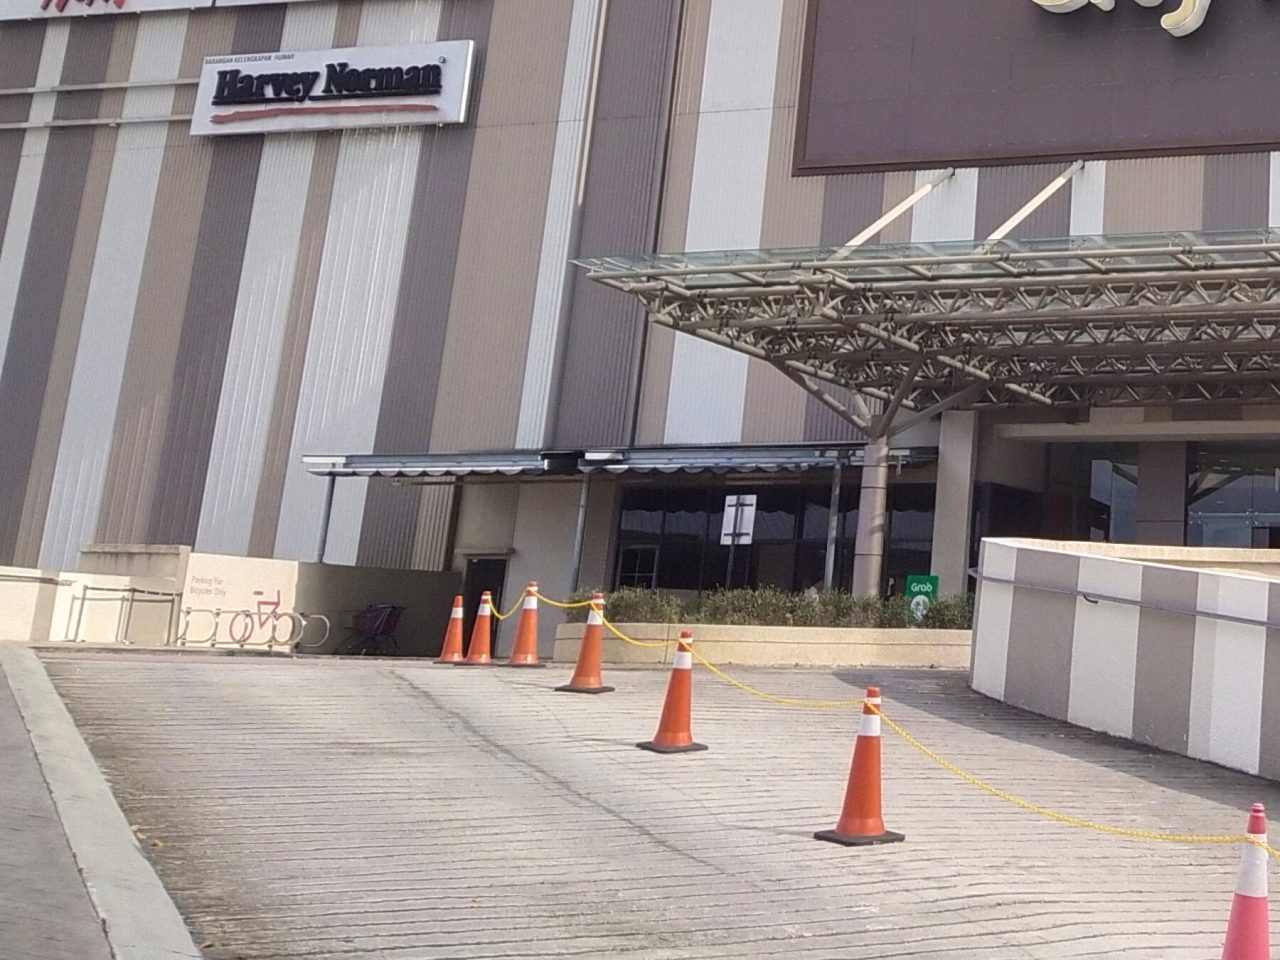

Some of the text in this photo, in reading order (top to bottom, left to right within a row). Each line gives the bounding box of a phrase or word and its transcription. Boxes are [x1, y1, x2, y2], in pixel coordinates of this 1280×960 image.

[213, 62, 443, 103] Harvey Norman
[910, 582, 933, 592] Grab
